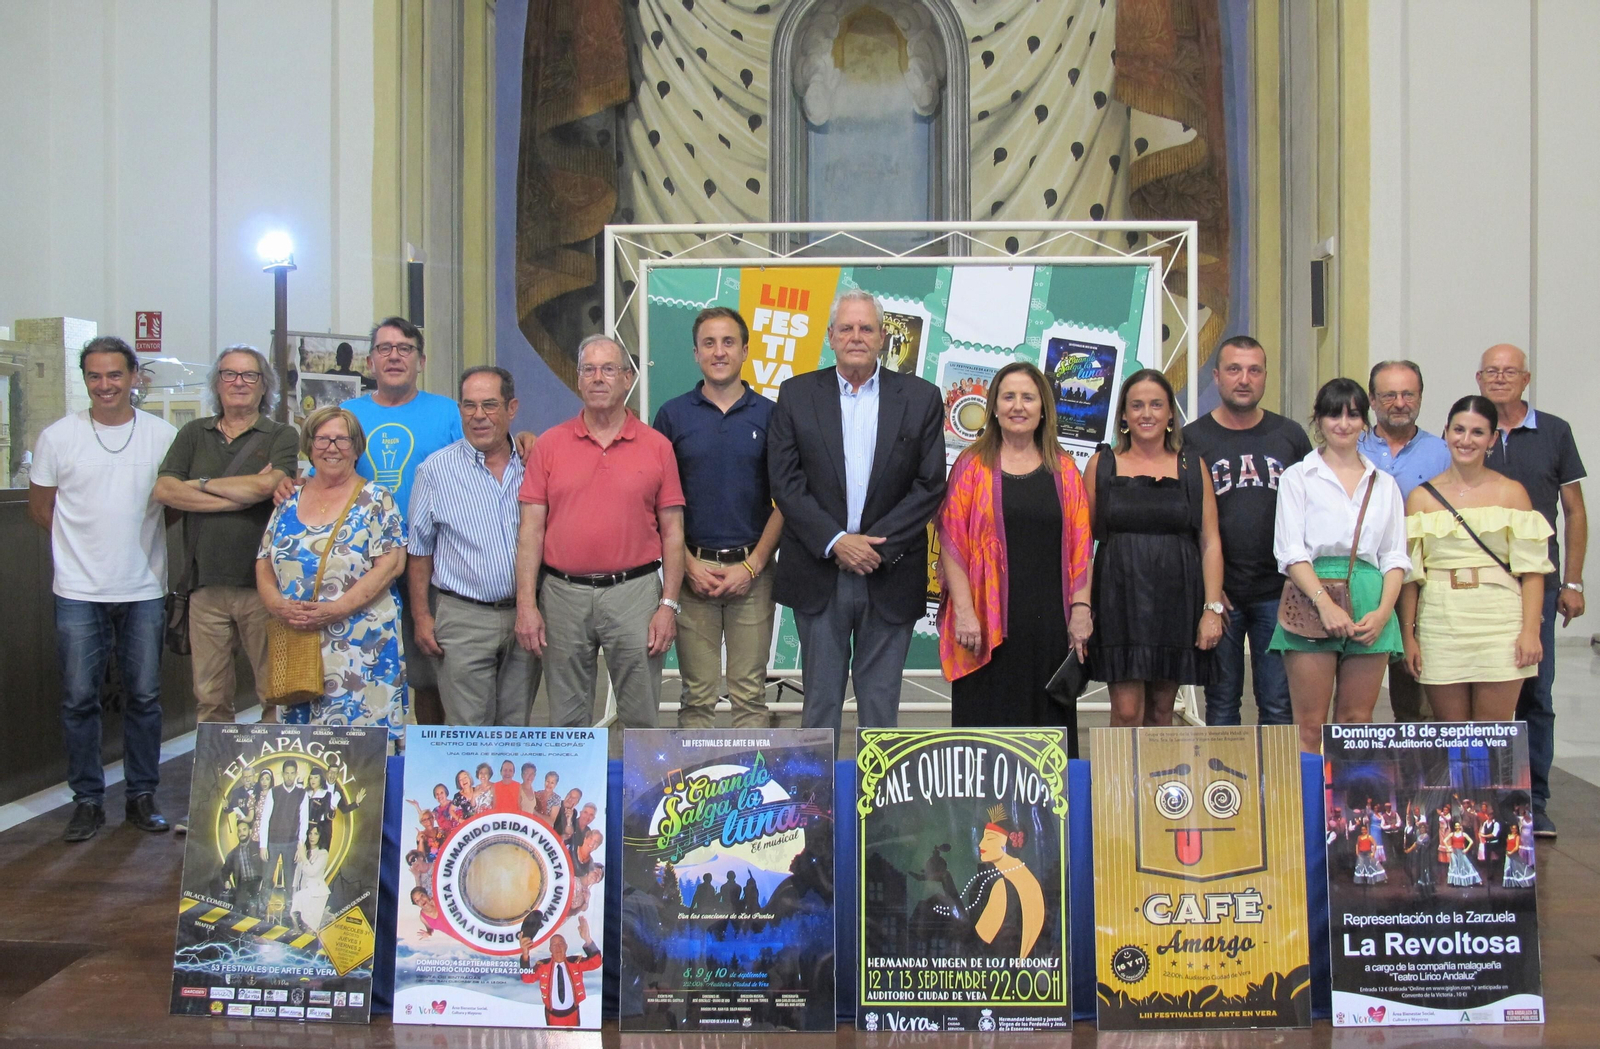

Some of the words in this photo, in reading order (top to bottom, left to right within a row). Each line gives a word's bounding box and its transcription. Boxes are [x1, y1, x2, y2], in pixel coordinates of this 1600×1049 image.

[760, 284, 810, 312] LIII
[752, 308, 809, 338] FES
[762, 334, 796, 362] TI
[752, 359, 794, 386] VA
[1077, 368, 1104, 380] luna
[422, 730, 436, 738] LIII
[440, 730, 502, 739] FESTIVALES
[505, 731, 518, 739] DE
[520, 731, 546, 740] ARTE
[551, 731, 565, 740] EN
[566, 731, 595, 740] VERA
[1332, 726, 1396, 740] Domingo
[1400, 726, 1416, 737] 18
[1420, 726, 1436, 737] de
[1439, 724, 1518, 740] septiembre
[682, 740, 692, 748] LIII
[692, 739, 723, 748] FESTIVALES
[724, 740, 732, 748] DE
[732, 740, 746, 748] ARTE
[748, 740, 755, 748] EN
[756, 740, 770, 748] VERA
[1344, 740, 1370, 748] 20.00
[1372, 740, 1386, 748] hs.
[1388, 739, 1432, 748] Auditorio
[1434, 738, 1469, 748] Ciudad
[1471, 738, 1483, 747] de
[1484, 738, 1506, 747] Vera
[223, 753, 256, 780] EL
[260, 737, 356, 785] APAGÓN
[688, 755, 770, 803] Cuando
[876, 761, 914, 808] ¿ME
[918, 746, 988, 805] QUIERE
[993, 753, 1008, 800] O
[1014, 760, 1050, 808] NO?
[656, 797, 732, 850] Salga
[738, 788, 762, 808] la
[722, 805, 800, 846] luna
[443, 859, 454, 878] UN
[450, 824, 492, 860] MARIDO
[492, 820, 508, 831] DE
[508, 822, 528, 835] IDA
[530, 828, 539, 838] Y
[538, 836, 564, 880] VUELTA
[750, 843, 762, 854] El
[764, 832, 800, 850] musical
[554, 886, 564, 904] UN
[443, 884, 468, 928] VUELTA
[1143, 888, 1264, 925] CAFÉ
[466, 925, 475, 934] Y
[1344, 913, 1433, 928] Representación
[1436, 912, 1450, 924] de
[1453, 912, 1464, 923] la
[1466, 911, 1516, 923] Zarzuela
[478, 929, 496, 942] IDA
[499, 933, 514, 944] DE
[1156, 930, 1256, 958] Amargo
[1344, 934, 1376, 957] La
[1385, 931, 1520, 956] Revoltosa
[222, 964, 266, 973] FESTIVALES
[868, 958, 928, 968] HERMANDAD
[932, 958, 967, 968] VIRGEN
[971, 958, 982, 968] DE
[986, 958, 1004, 968] LOS
[1010, 958, 1060, 968] PERDONES
[1372, 964, 1394, 974] cargo
[1396, 962, 1406, 971] de
[1408, 962, 1415, 970] la
[1417, 962, 1456, 973] compañía
[1458, 961, 1502, 972] malagueña
[696, 968, 704, 978] 9
[704, 971, 712, 982] y
[715, 968, 728, 978] 10
[738, 972, 768, 980] septiembre
[868, 970, 882, 988] 12
[886, 970, 894, 988] Y
[900, 970, 912, 988] 13
[918, 970, 987, 989] SEPTIEMBRE
[990, 970, 1060, 1000] 22:00H
[1420, 972, 1442, 981] Lírico
[867, 991, 914, 1000] AUDITORIO
[917, 991, 949, 1000] CIUDAD
[952, 991, 964, 1000] DE
[966, 991, 988, 1000] VERA
[886, 1011, 930, 1031] Vera
